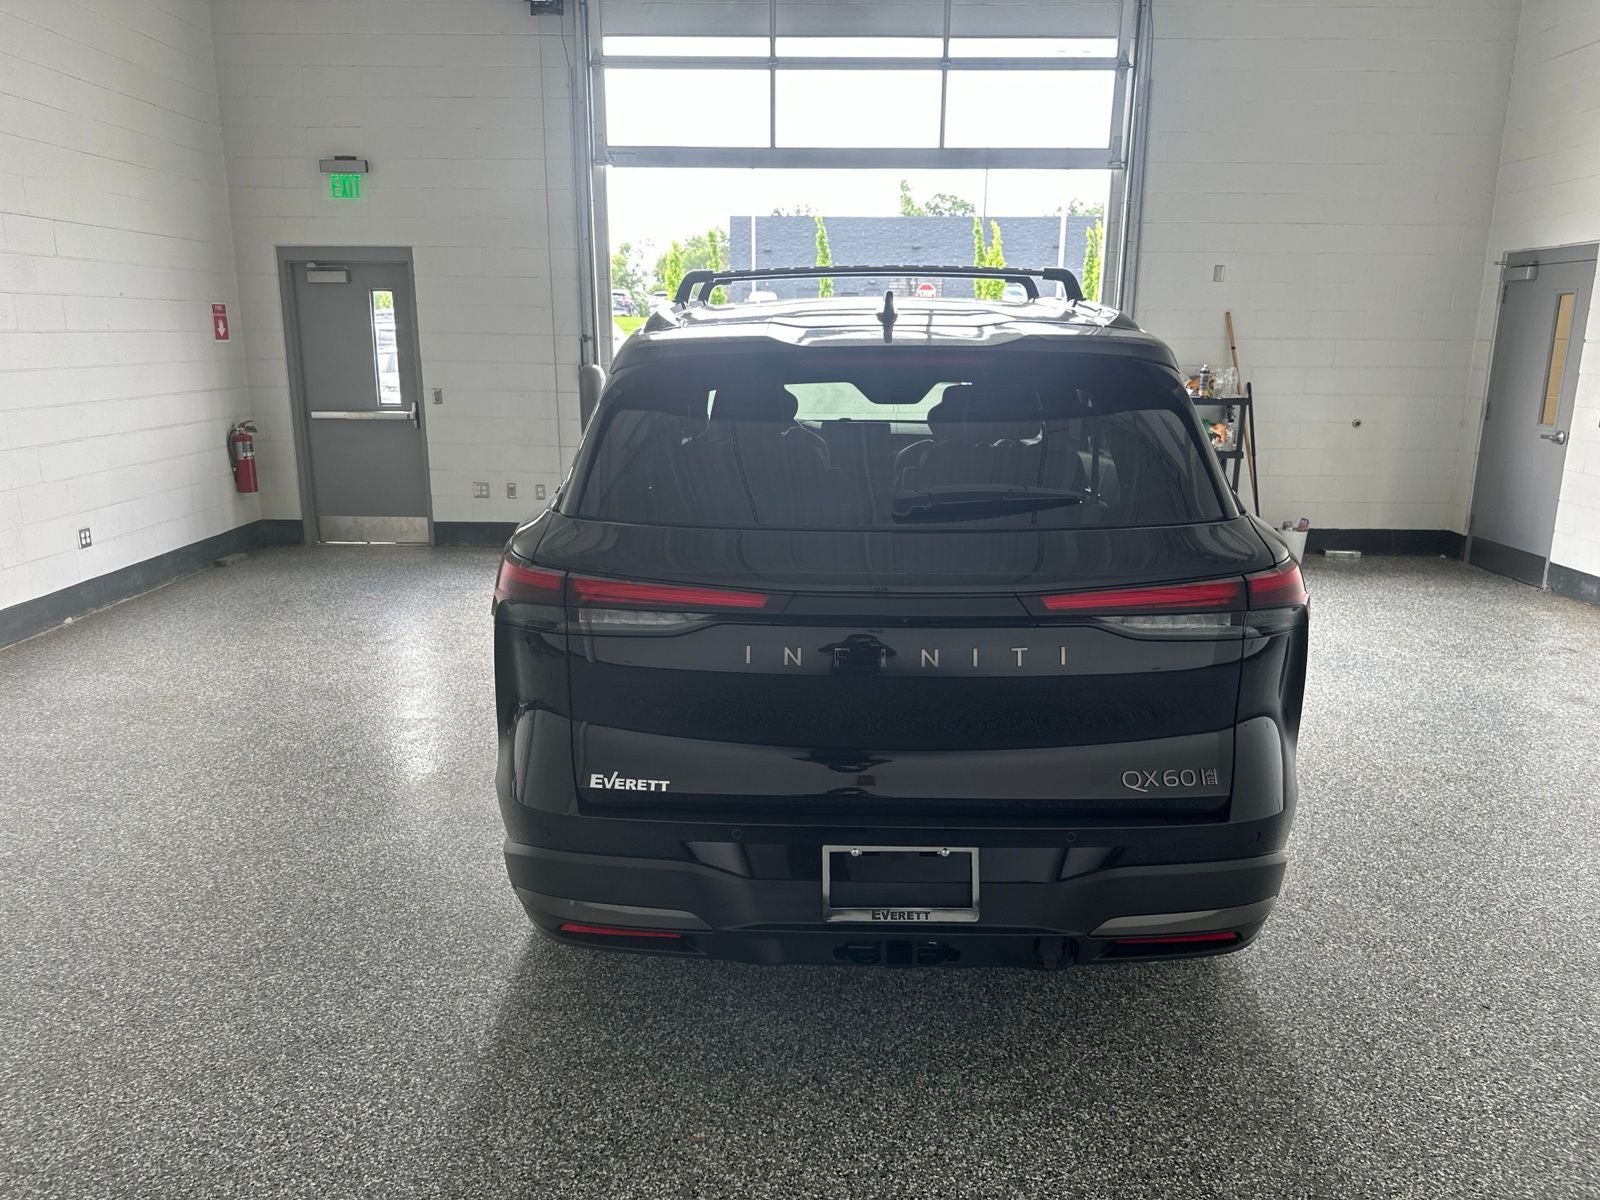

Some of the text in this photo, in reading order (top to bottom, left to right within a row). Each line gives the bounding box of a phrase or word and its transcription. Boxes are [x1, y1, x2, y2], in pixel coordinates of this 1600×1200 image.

[331, 174, 361, 199] EXIT
[745, 645, 1067, 668] INFINITI
[589, 771, 670, 792] EVERETT
[1122, 768, 1196, 792] QX60
[871, 908, 931, 921] EVERETT
